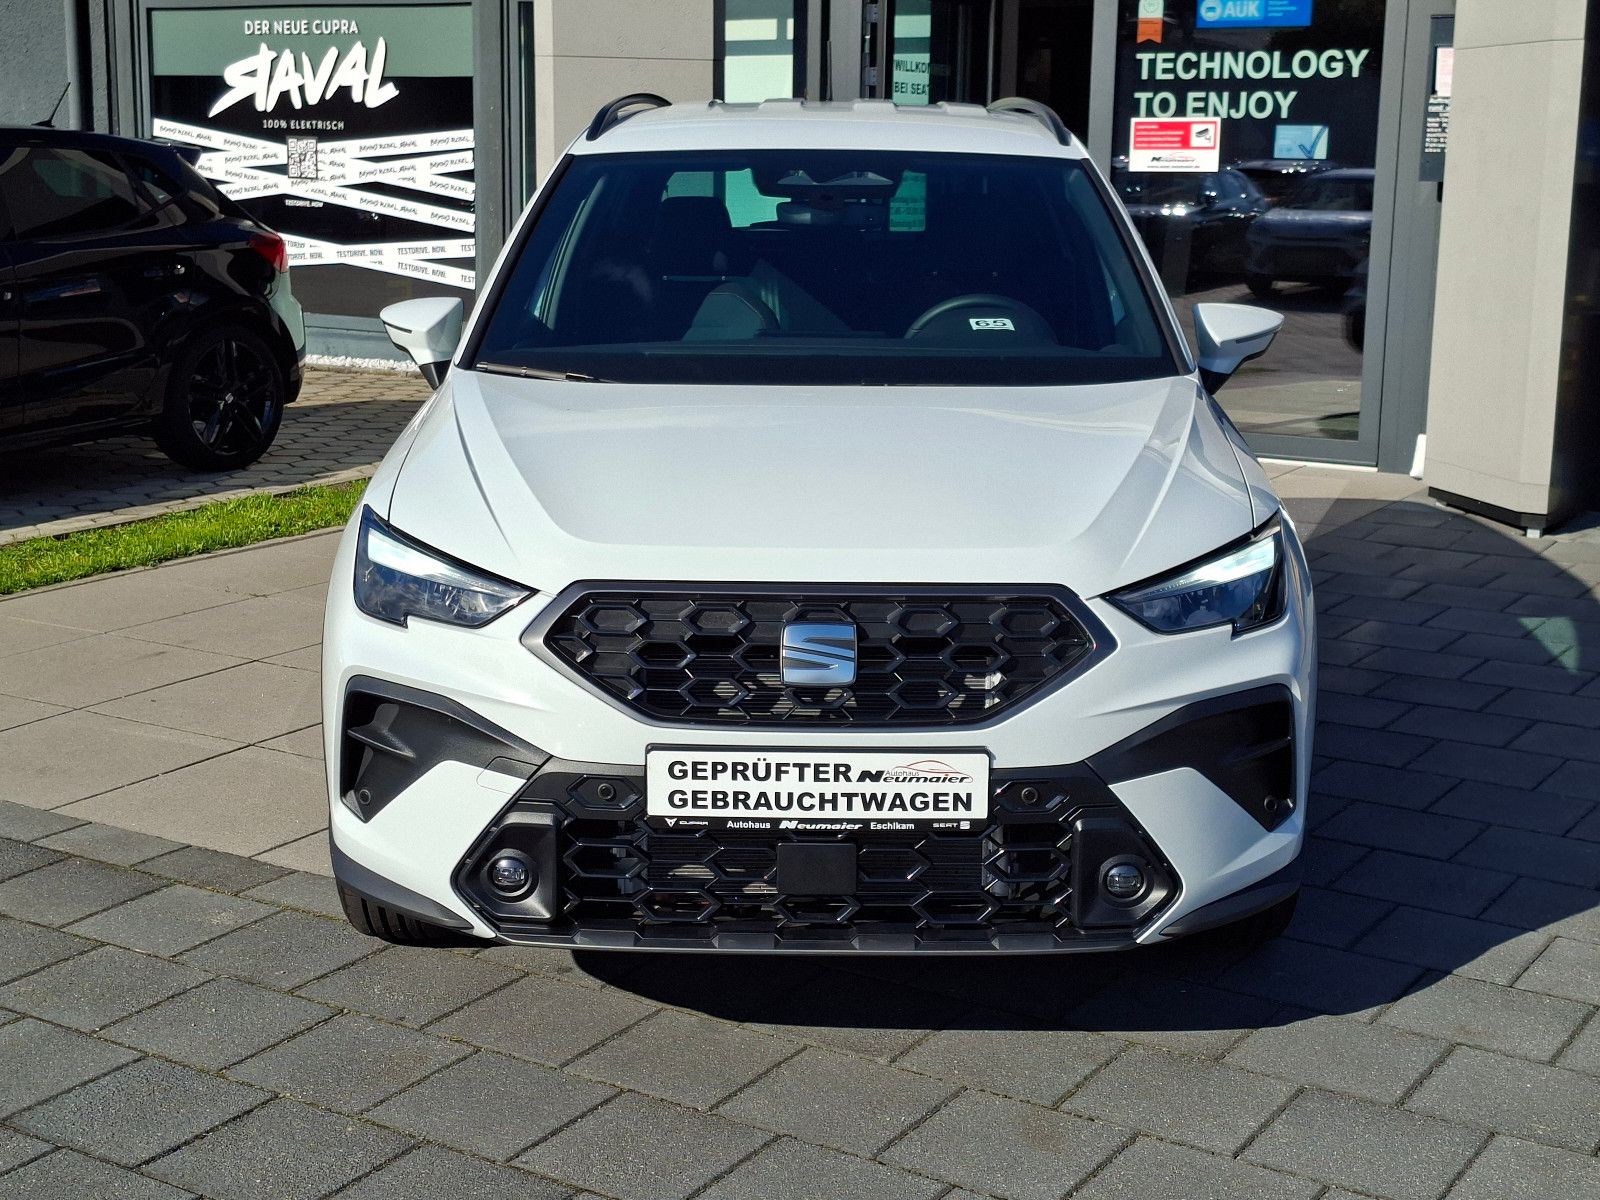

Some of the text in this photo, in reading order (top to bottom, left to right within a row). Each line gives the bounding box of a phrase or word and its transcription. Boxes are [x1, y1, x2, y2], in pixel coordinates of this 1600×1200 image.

[244, 19, 359, 35] DER NEUE CUPRA
[895, 59, 931, 74] WILLKO
[1135, 49, 1370, 80] TECHNOLOGY
[207, 36, 400, 118] RAVAL
[894, 82, 908, 94] BEI
[1134, 91, 1298, 119] TO ENJOY
[262, 119, 345, 130] 100% ELEKTRISCH
[668, 757, 853, 783] GEPRÜFTER
[856, 769, 971, 784] Neumaier
[668, 789, 972, 812] GEBRAUCHTWAGEN
[726, 820, 915, 830] Autohaus Neumaier Eschlkam
